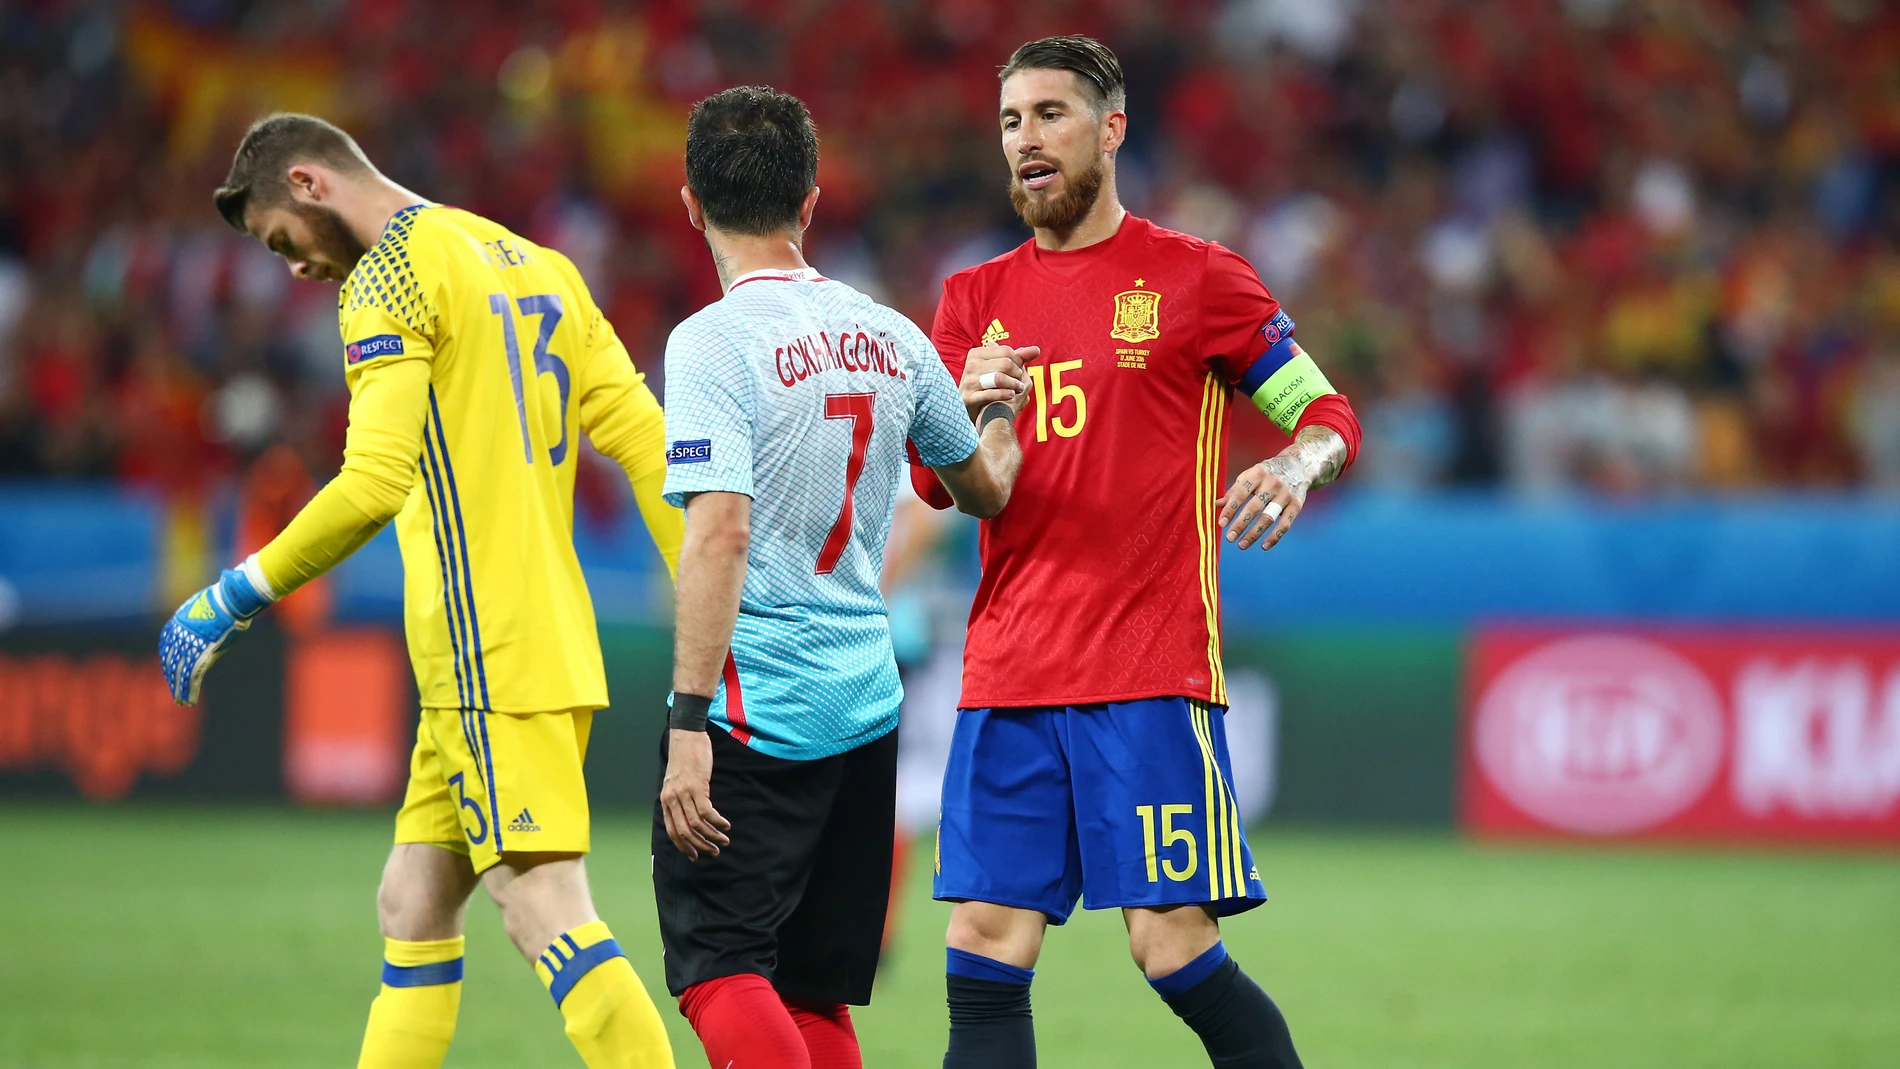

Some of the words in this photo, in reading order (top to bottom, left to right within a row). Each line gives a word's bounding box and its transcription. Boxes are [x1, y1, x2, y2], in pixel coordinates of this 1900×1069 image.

[361, 339, 402, 356] RESPECT
[488, 293, 571, 467] 13
[1027, 359, 1087, 443] 15
[1273, 375, 1306, 406] RACISM
[1279, 391, 1312, 425] RESPECT
[670, 445, 711, 459] ESPECT
[815, 391, 877, 576] 7
[448, 770, 488, 845] 3
[507, 824, 542, 832] adidas
[1136, 803, 1198, 883] 15
